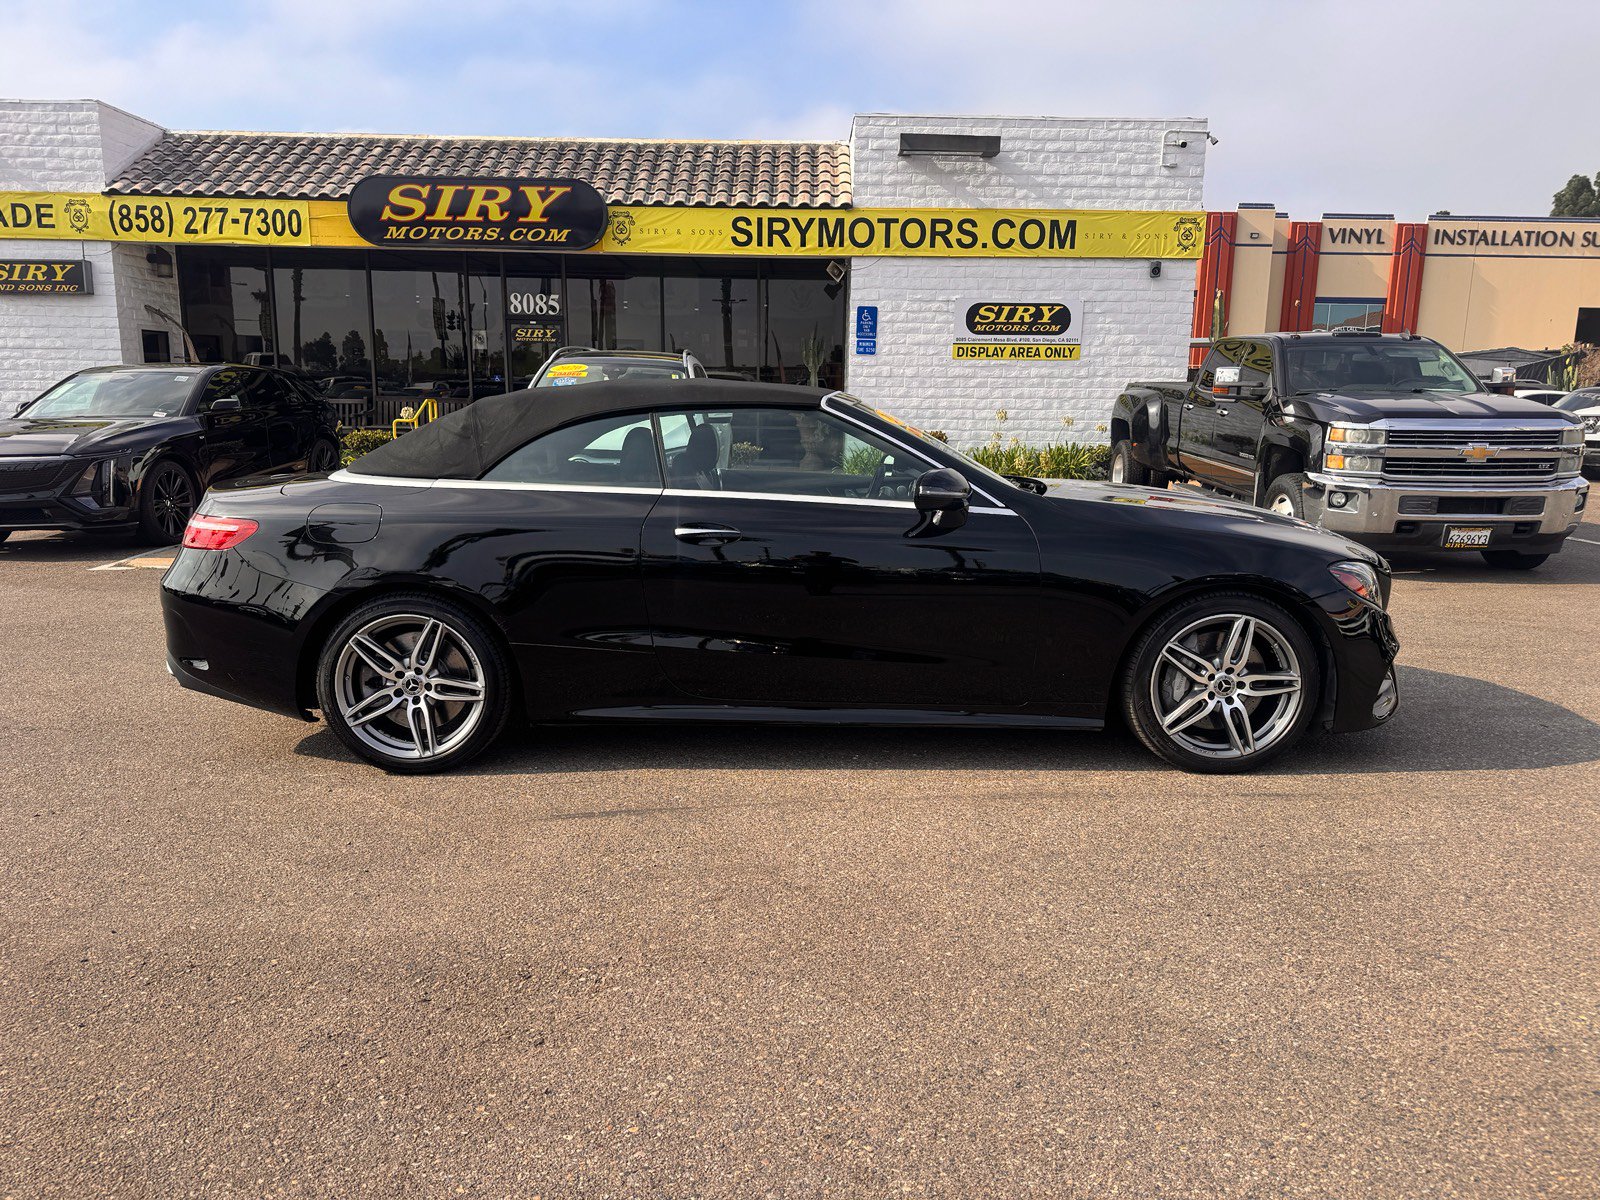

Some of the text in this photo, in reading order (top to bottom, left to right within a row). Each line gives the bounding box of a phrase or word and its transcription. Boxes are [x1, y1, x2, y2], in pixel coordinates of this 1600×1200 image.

[379, 184, 572, 223] SIRY
[108, 199, 302, 237] (858) 277-7300
[383, 226, 571, 243] MOTORS.COM
[639, 227, 668, 235] SIRY
[730, 215, 1077, 250] SIRYMOTORS.COM
[1328, 227, 1386, 245] VINYL
[1433, 229, 1574, 247] INSTALLATION
[17, 284, 52, 292] SONS
[54, 284, 79, 292] INC
[509, 292, 560, 315] 8085
[973, 305, 1064, 323] SIRY
[515, 328, 557, 338] SIRY
[973, 324, 1062, 332] MOTORS.COM
[956, 346, 1076, 358] DISPLAY AREA ONLY
[1448, 534, 1488, 544] 62696Y3
